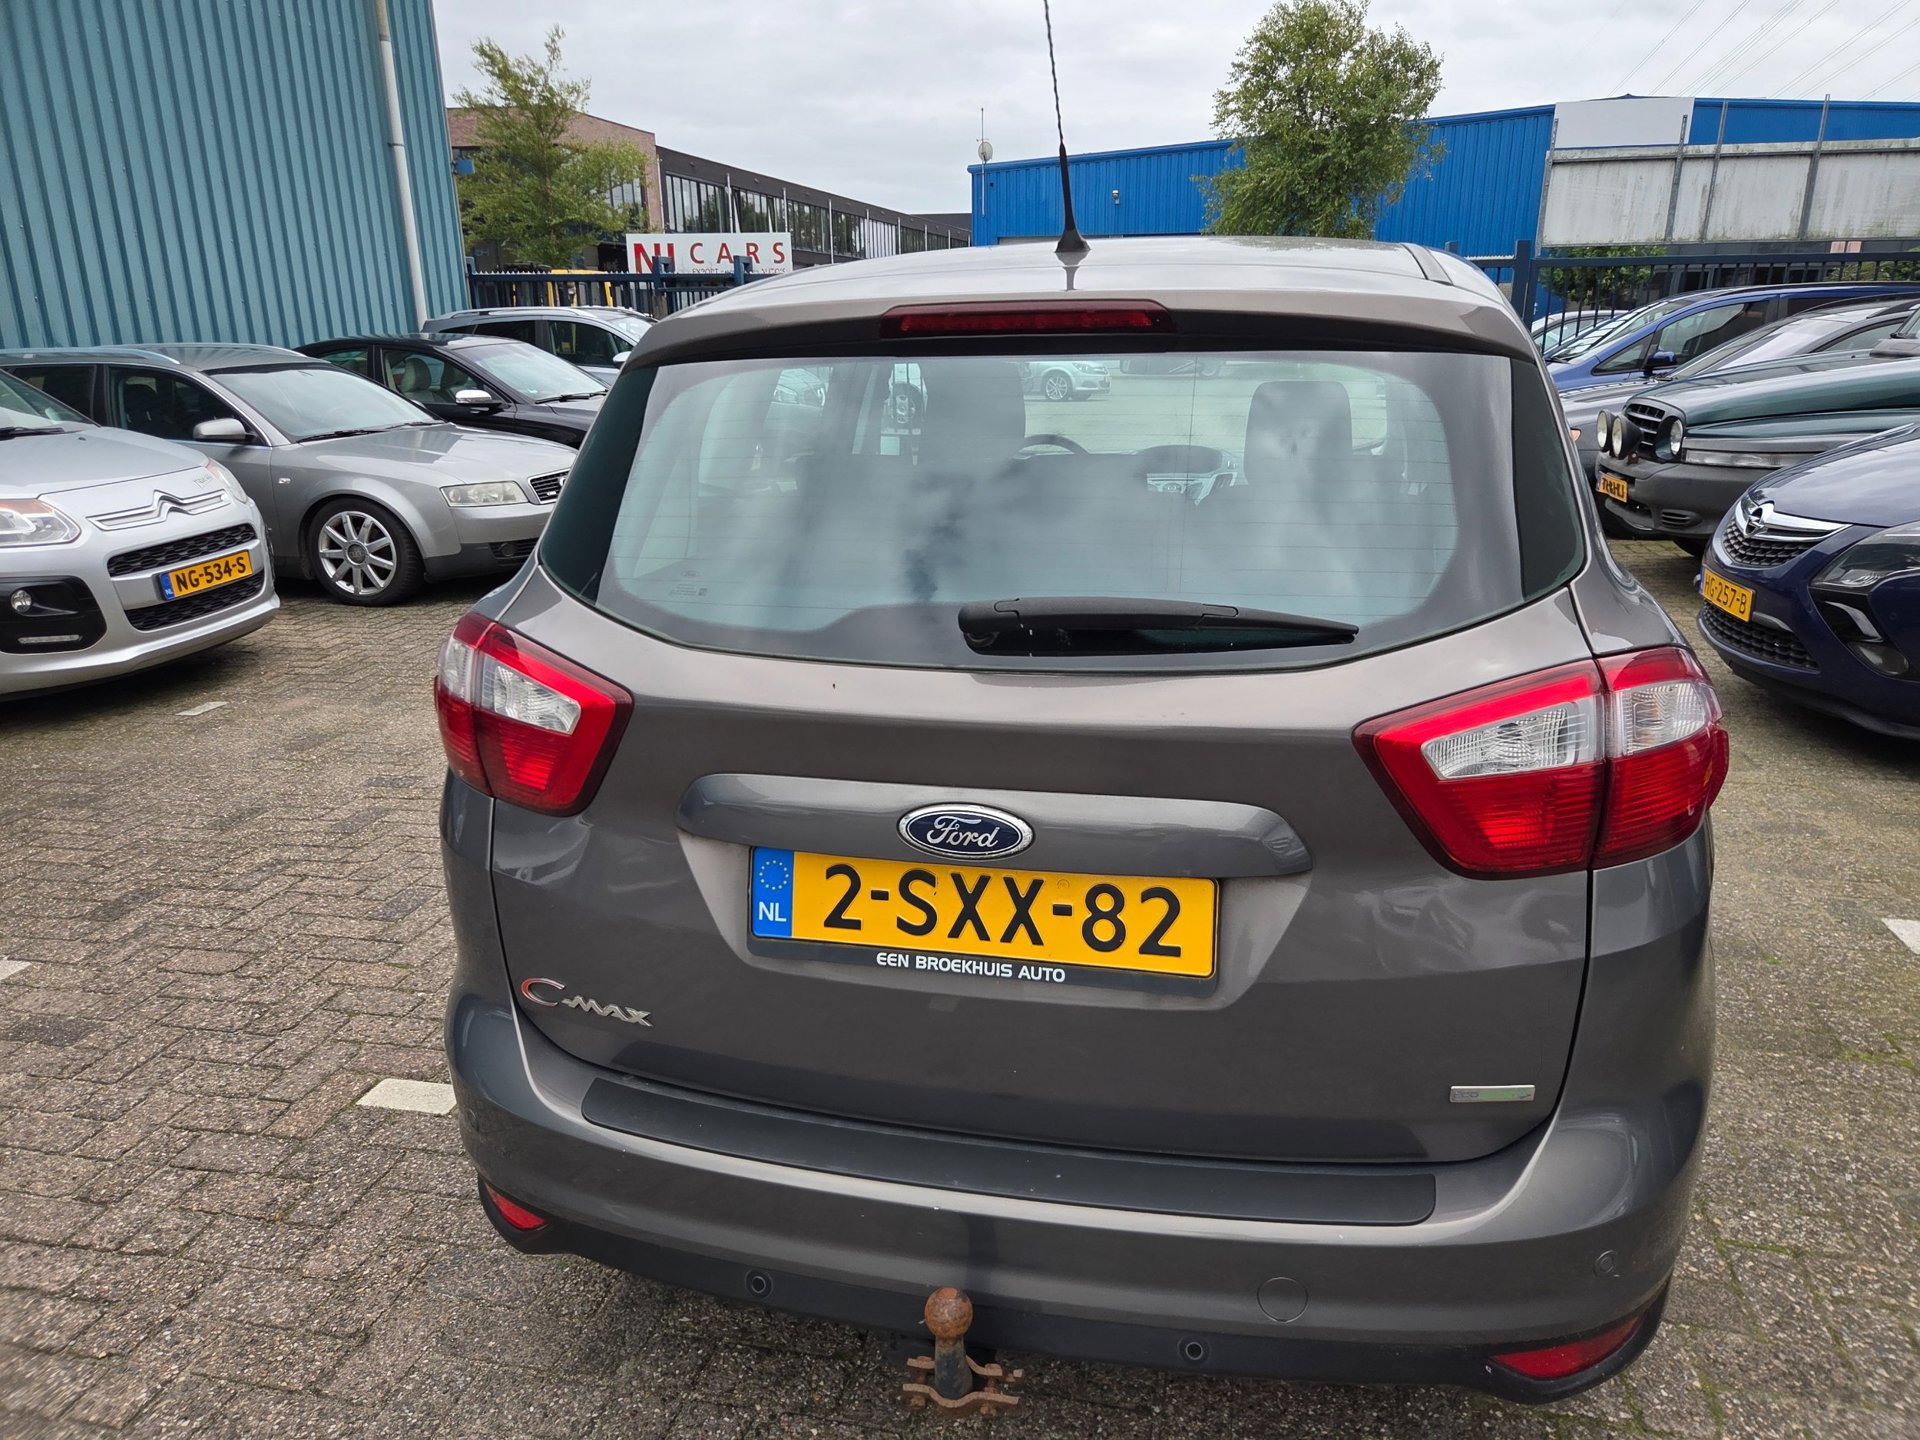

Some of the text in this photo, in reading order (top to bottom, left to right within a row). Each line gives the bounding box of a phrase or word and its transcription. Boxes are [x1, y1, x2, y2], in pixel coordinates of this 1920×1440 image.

[689, 242, 786, 265] CARS
[175, 556, 246, 592] NG-534-S
[1704, 573, 1747, 615] HG-257-B
[926, 815, 1001, 848] Ford
[758, 901, 787, 923] NL
[823, 863, 1182, 958] 2-SXX-82
[876, 952, 1066, 983] EEN BROEKHUIS AUTO
[521, 978, 653, 1027] C-MAX
